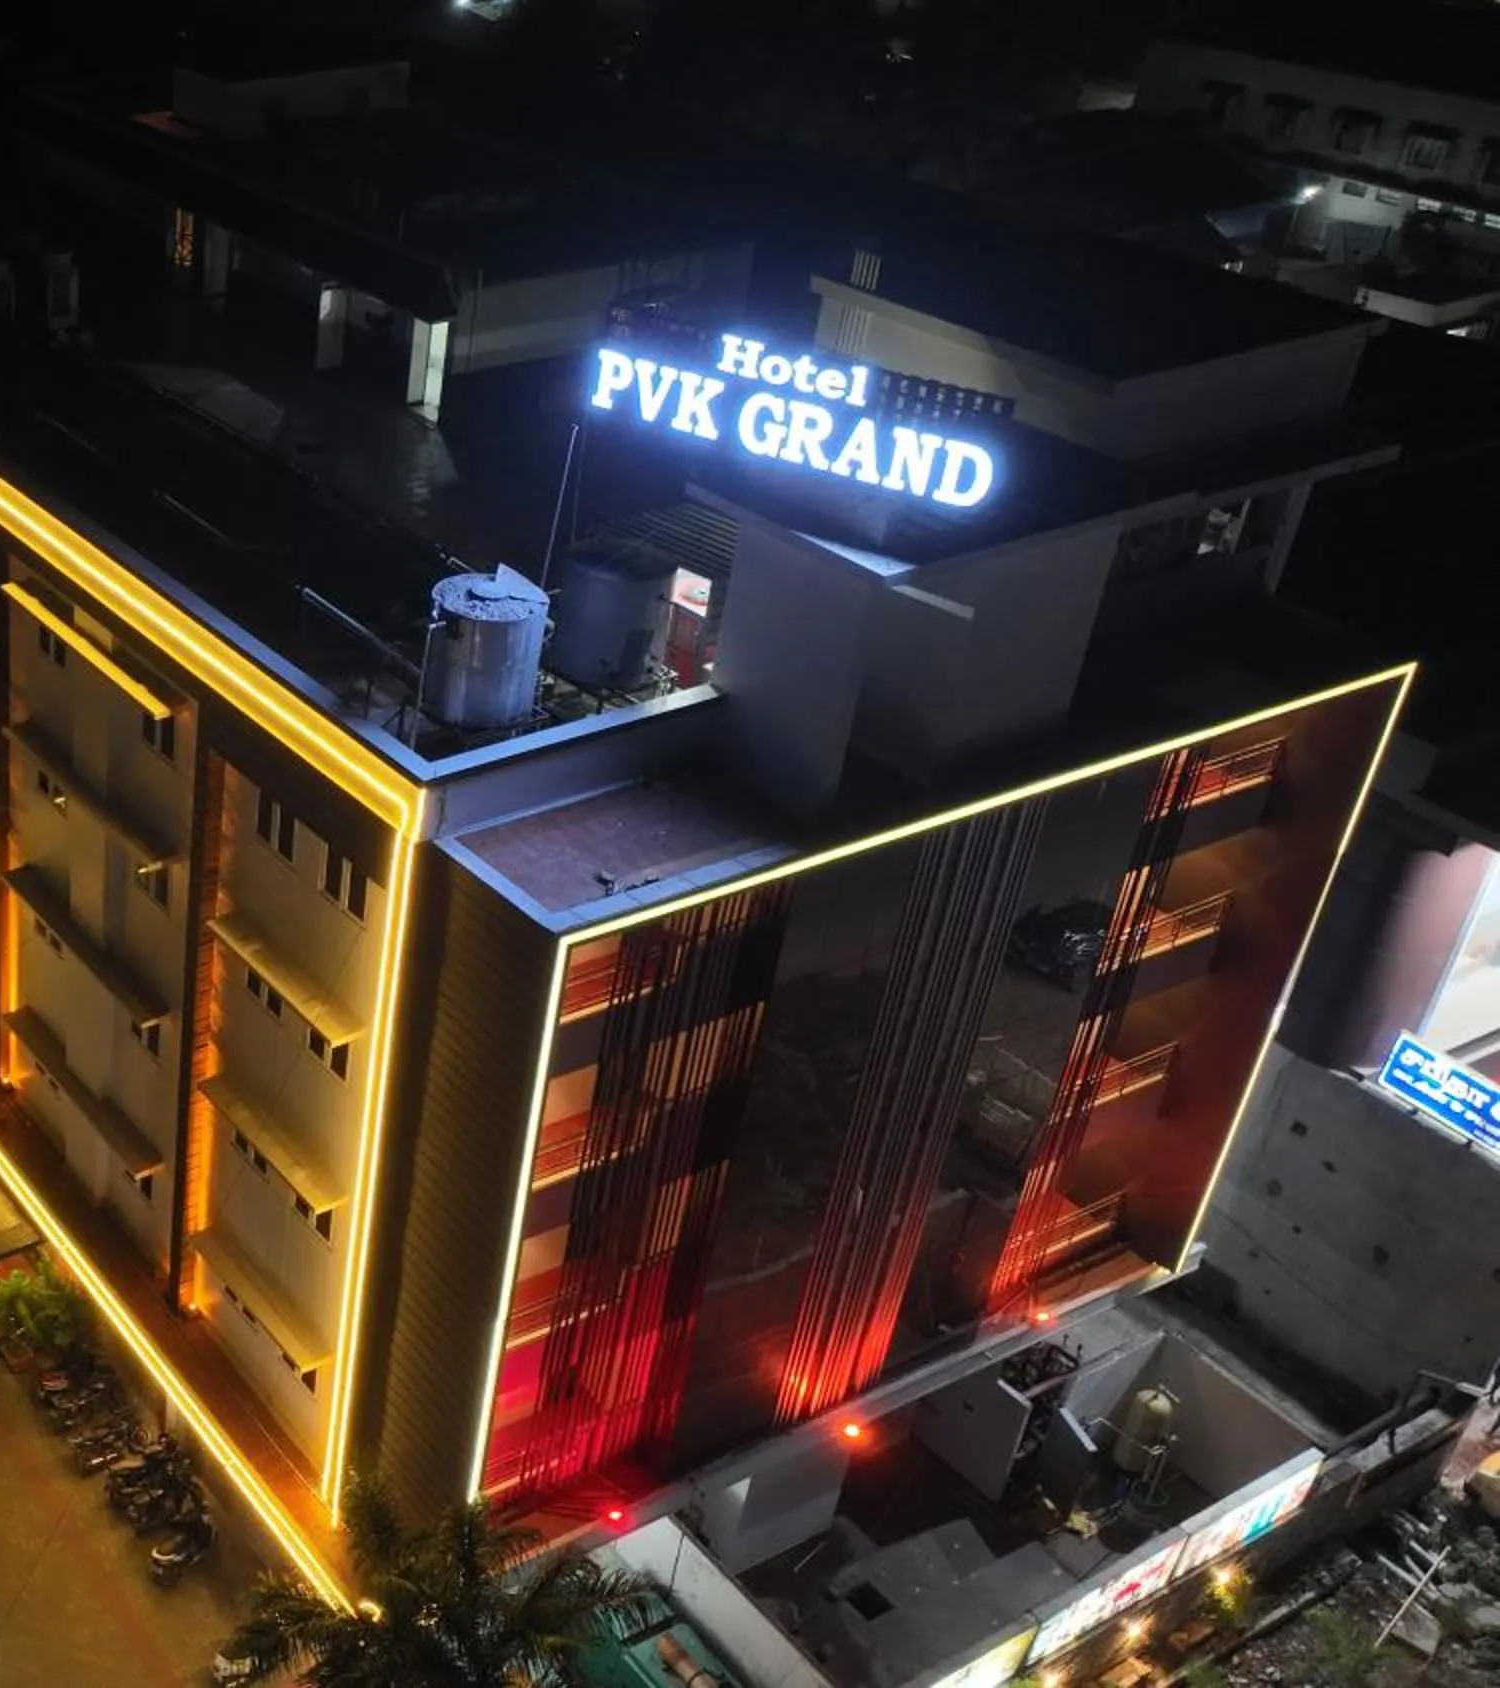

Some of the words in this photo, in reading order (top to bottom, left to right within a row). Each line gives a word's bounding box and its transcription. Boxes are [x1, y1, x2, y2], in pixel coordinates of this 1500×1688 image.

[591, 348, 725, 440] PVK
[738, 392, 994, 508] GRAND
[717, 334, 869, 407] Hotel
